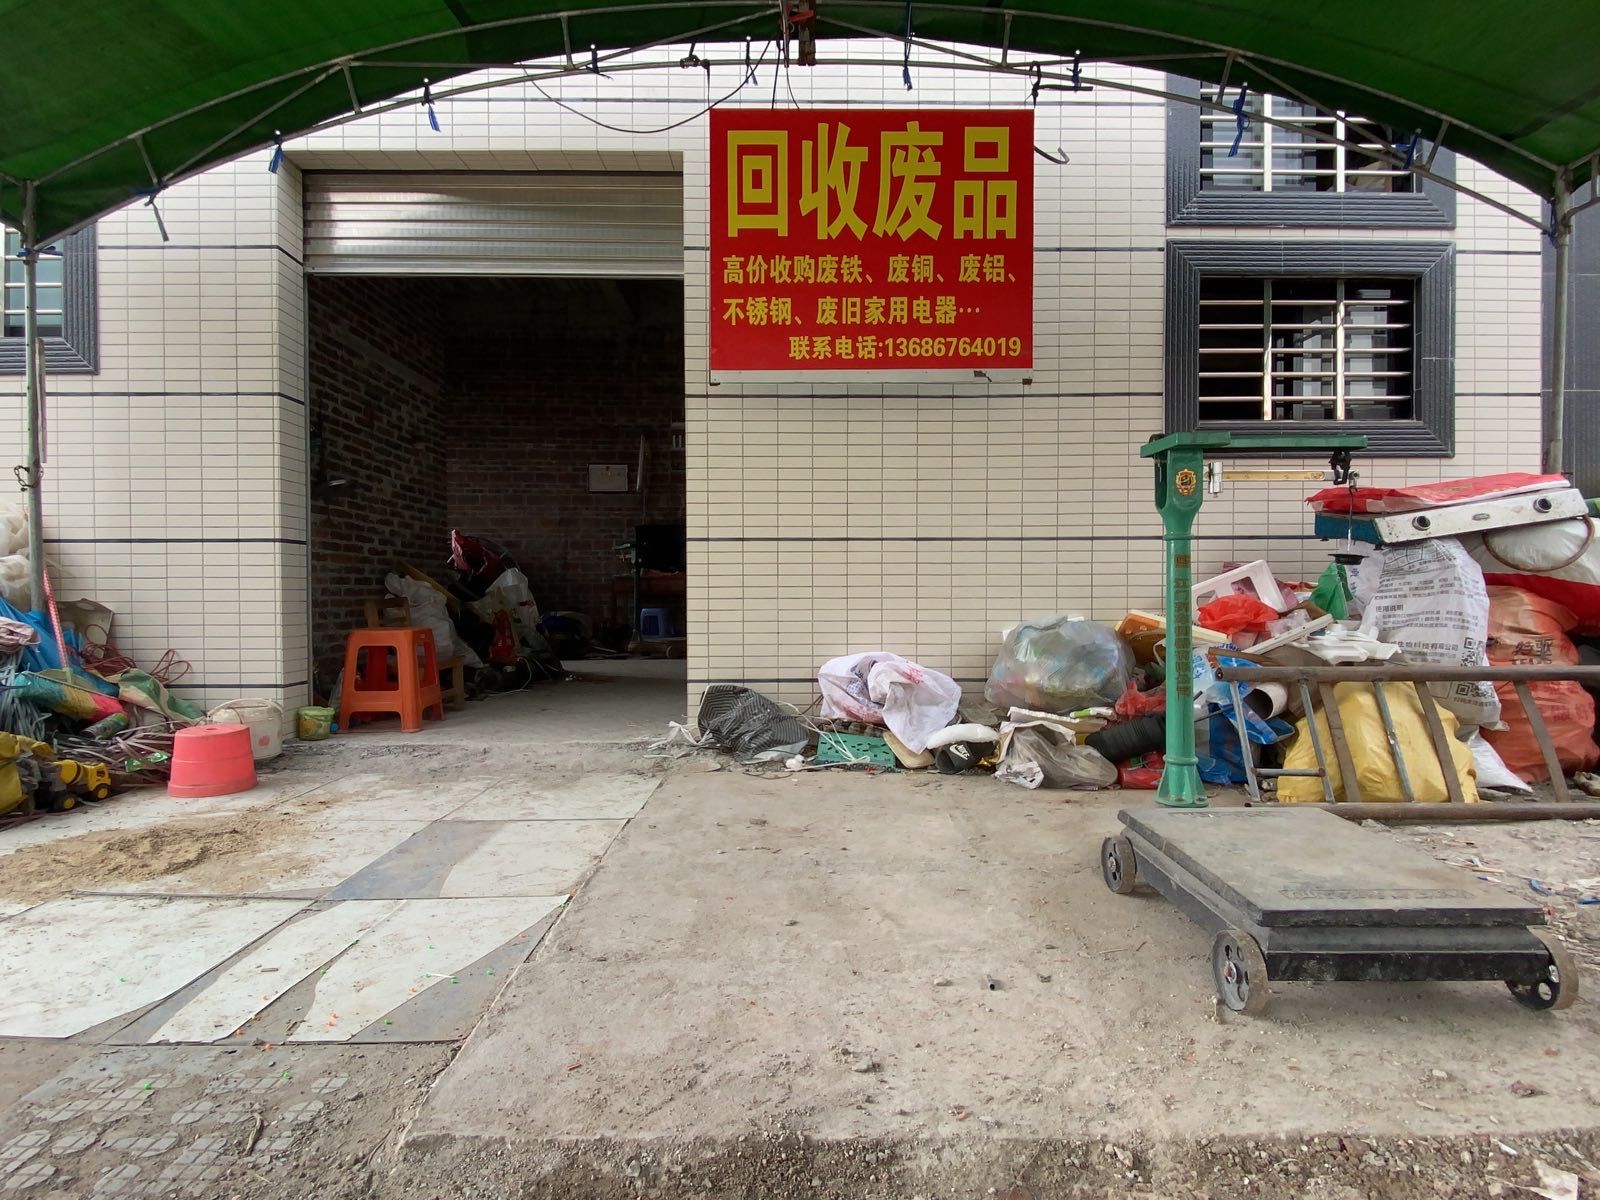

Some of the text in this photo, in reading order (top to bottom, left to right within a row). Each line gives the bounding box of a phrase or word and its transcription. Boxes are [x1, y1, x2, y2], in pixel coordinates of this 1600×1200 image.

[727, 120, 1018, 242] 回收废品
[722, 254, 1017, 284] 高价收购废铁、废铜、废铝、
[788, 335, 1022, 361] 联系电话:13686764019
[1392, 640, 1459, 652] 生物科技有限公司
